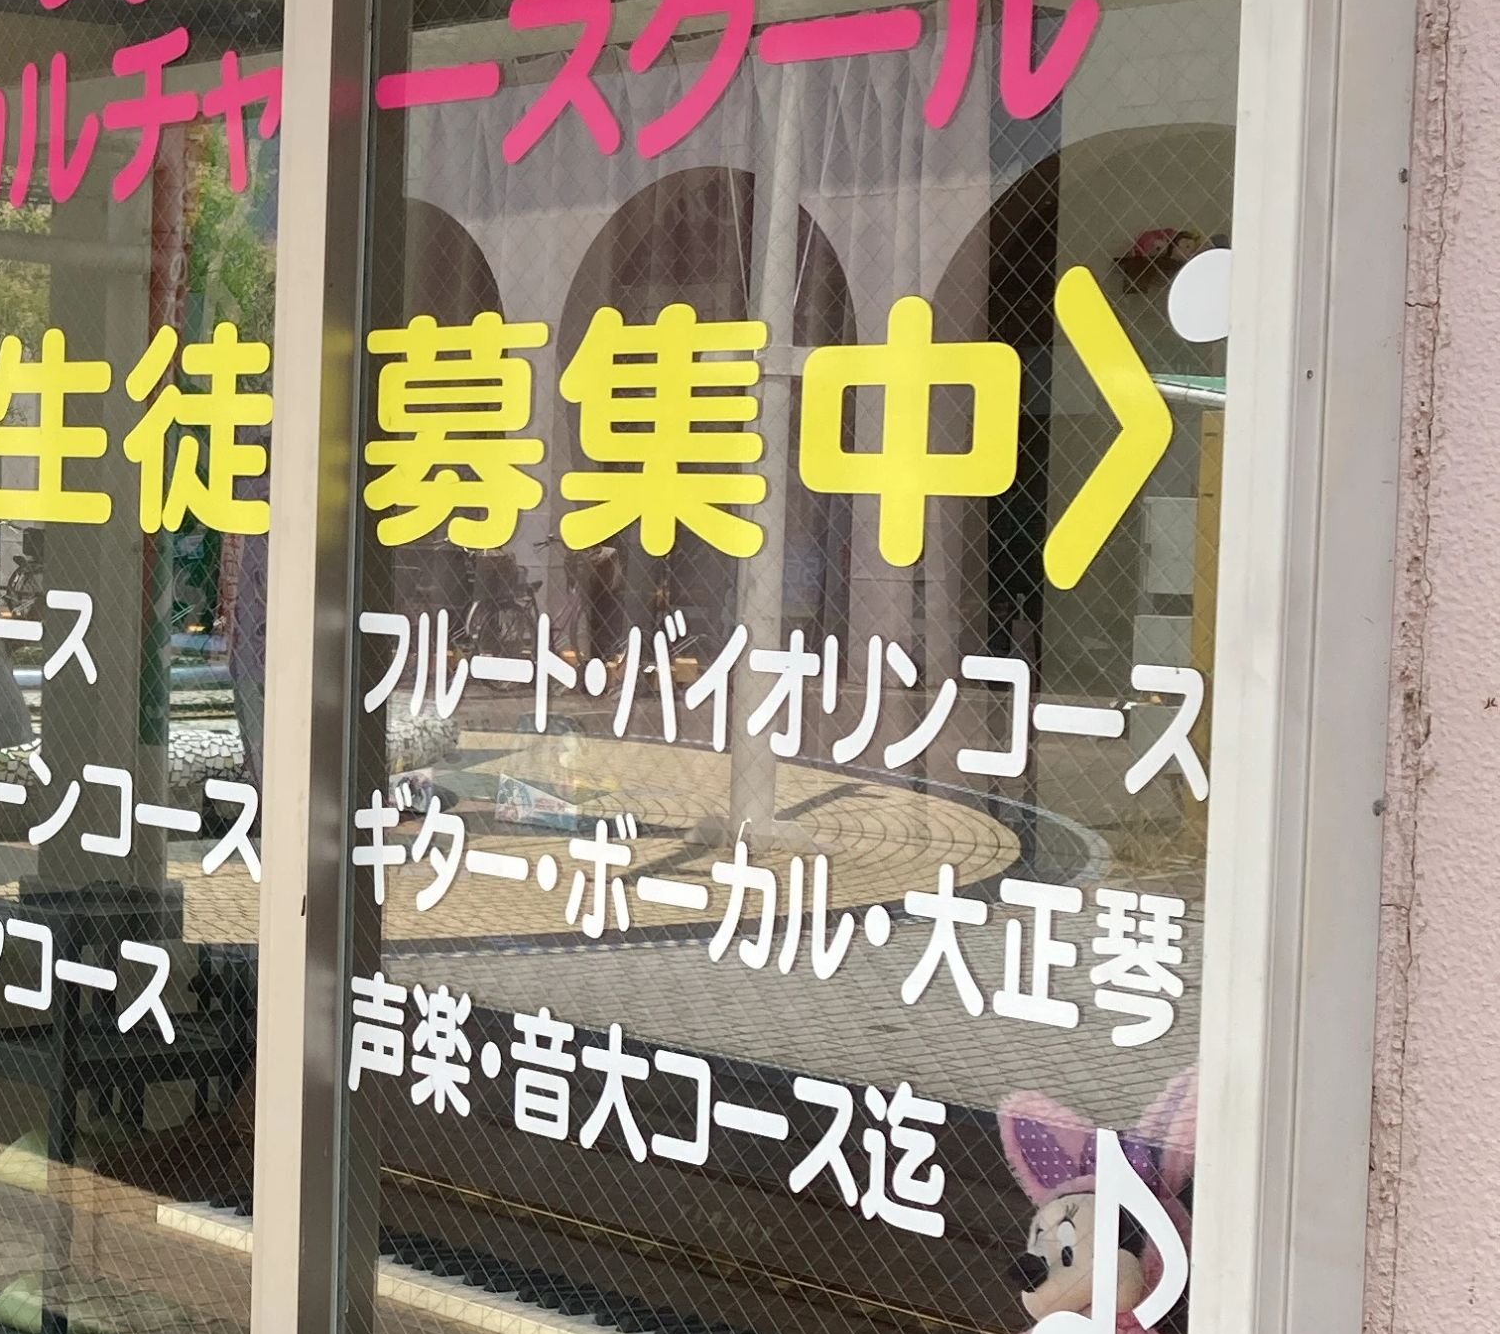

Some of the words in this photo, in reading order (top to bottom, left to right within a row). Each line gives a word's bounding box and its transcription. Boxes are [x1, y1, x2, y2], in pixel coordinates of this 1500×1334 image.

[357, 607, 1209, 803] フルート・バイオリンコース
[351, 788, 1188, 1049] ギター・ボーカル・大正琴
[346, 970, 948, 1241] 声楽・音大コース迄
